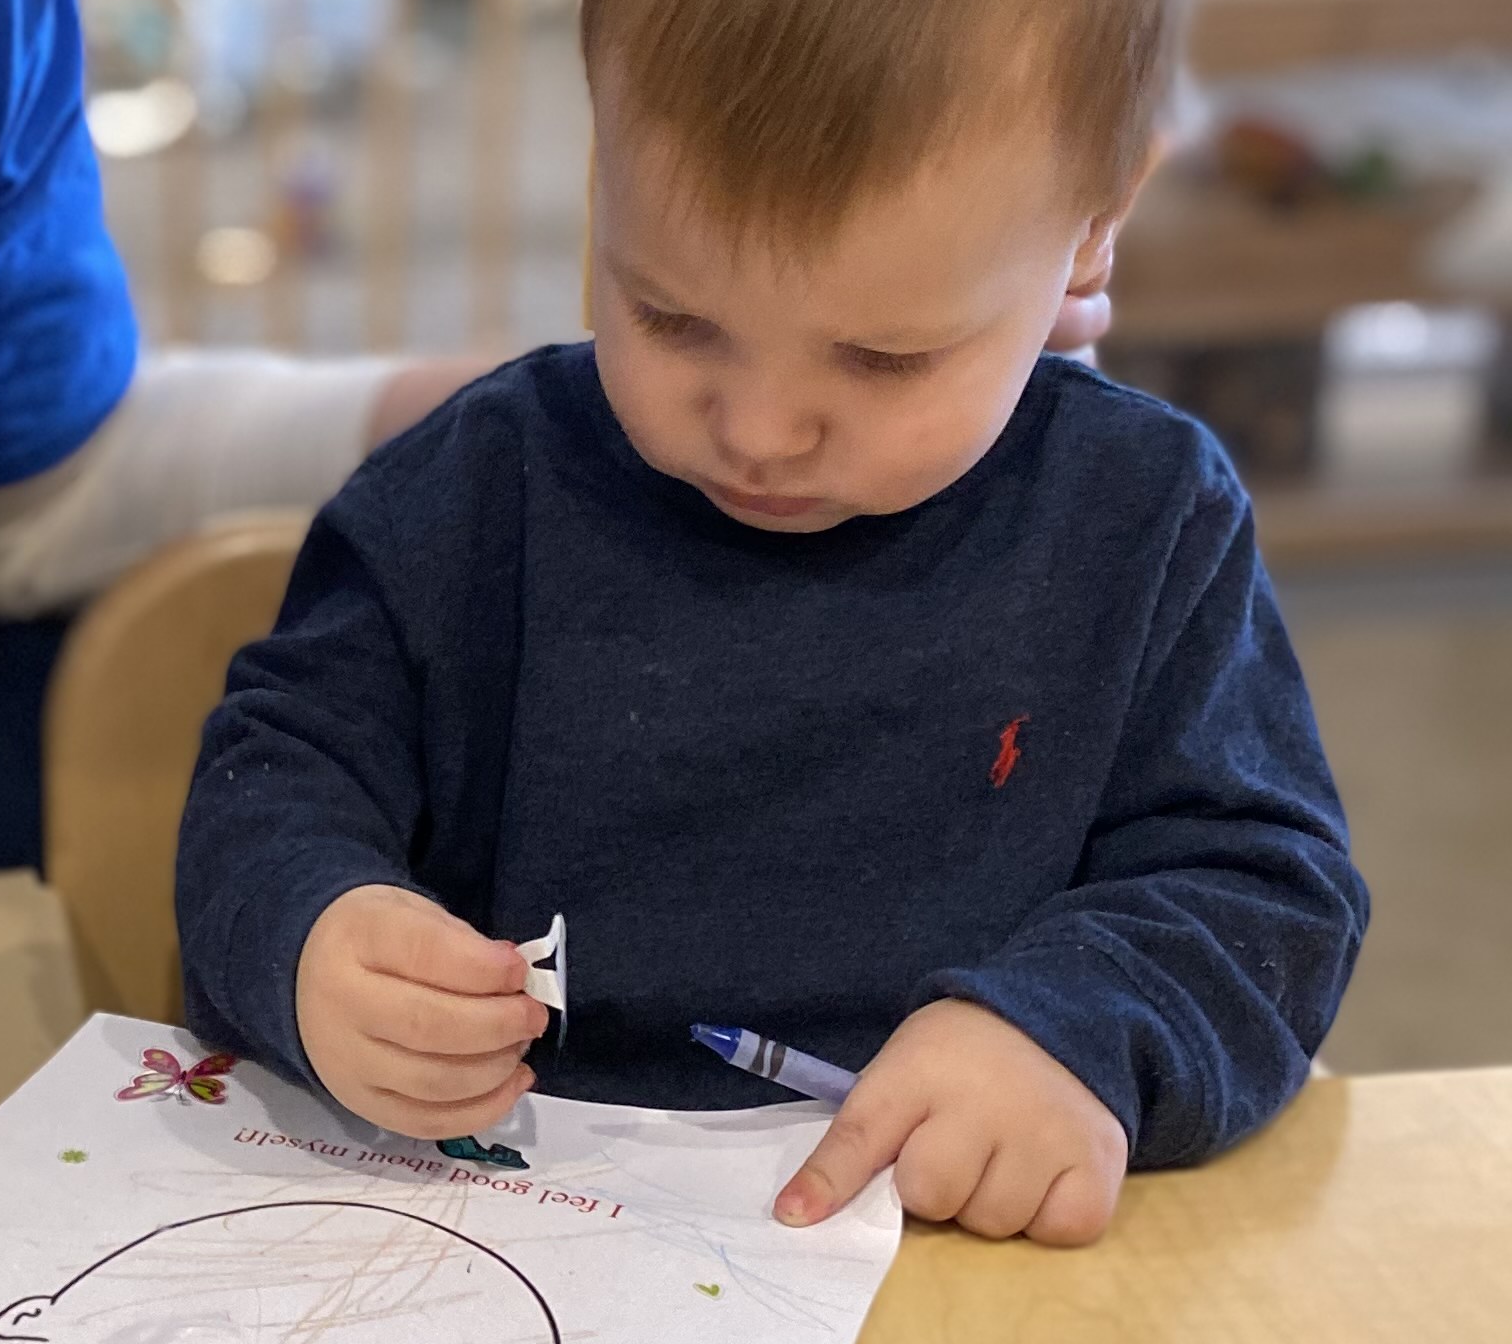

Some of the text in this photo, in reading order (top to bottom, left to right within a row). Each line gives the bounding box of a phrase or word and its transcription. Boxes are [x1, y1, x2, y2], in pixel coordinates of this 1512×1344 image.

[233, 1126, 625, 1220] I feel good about myself!
